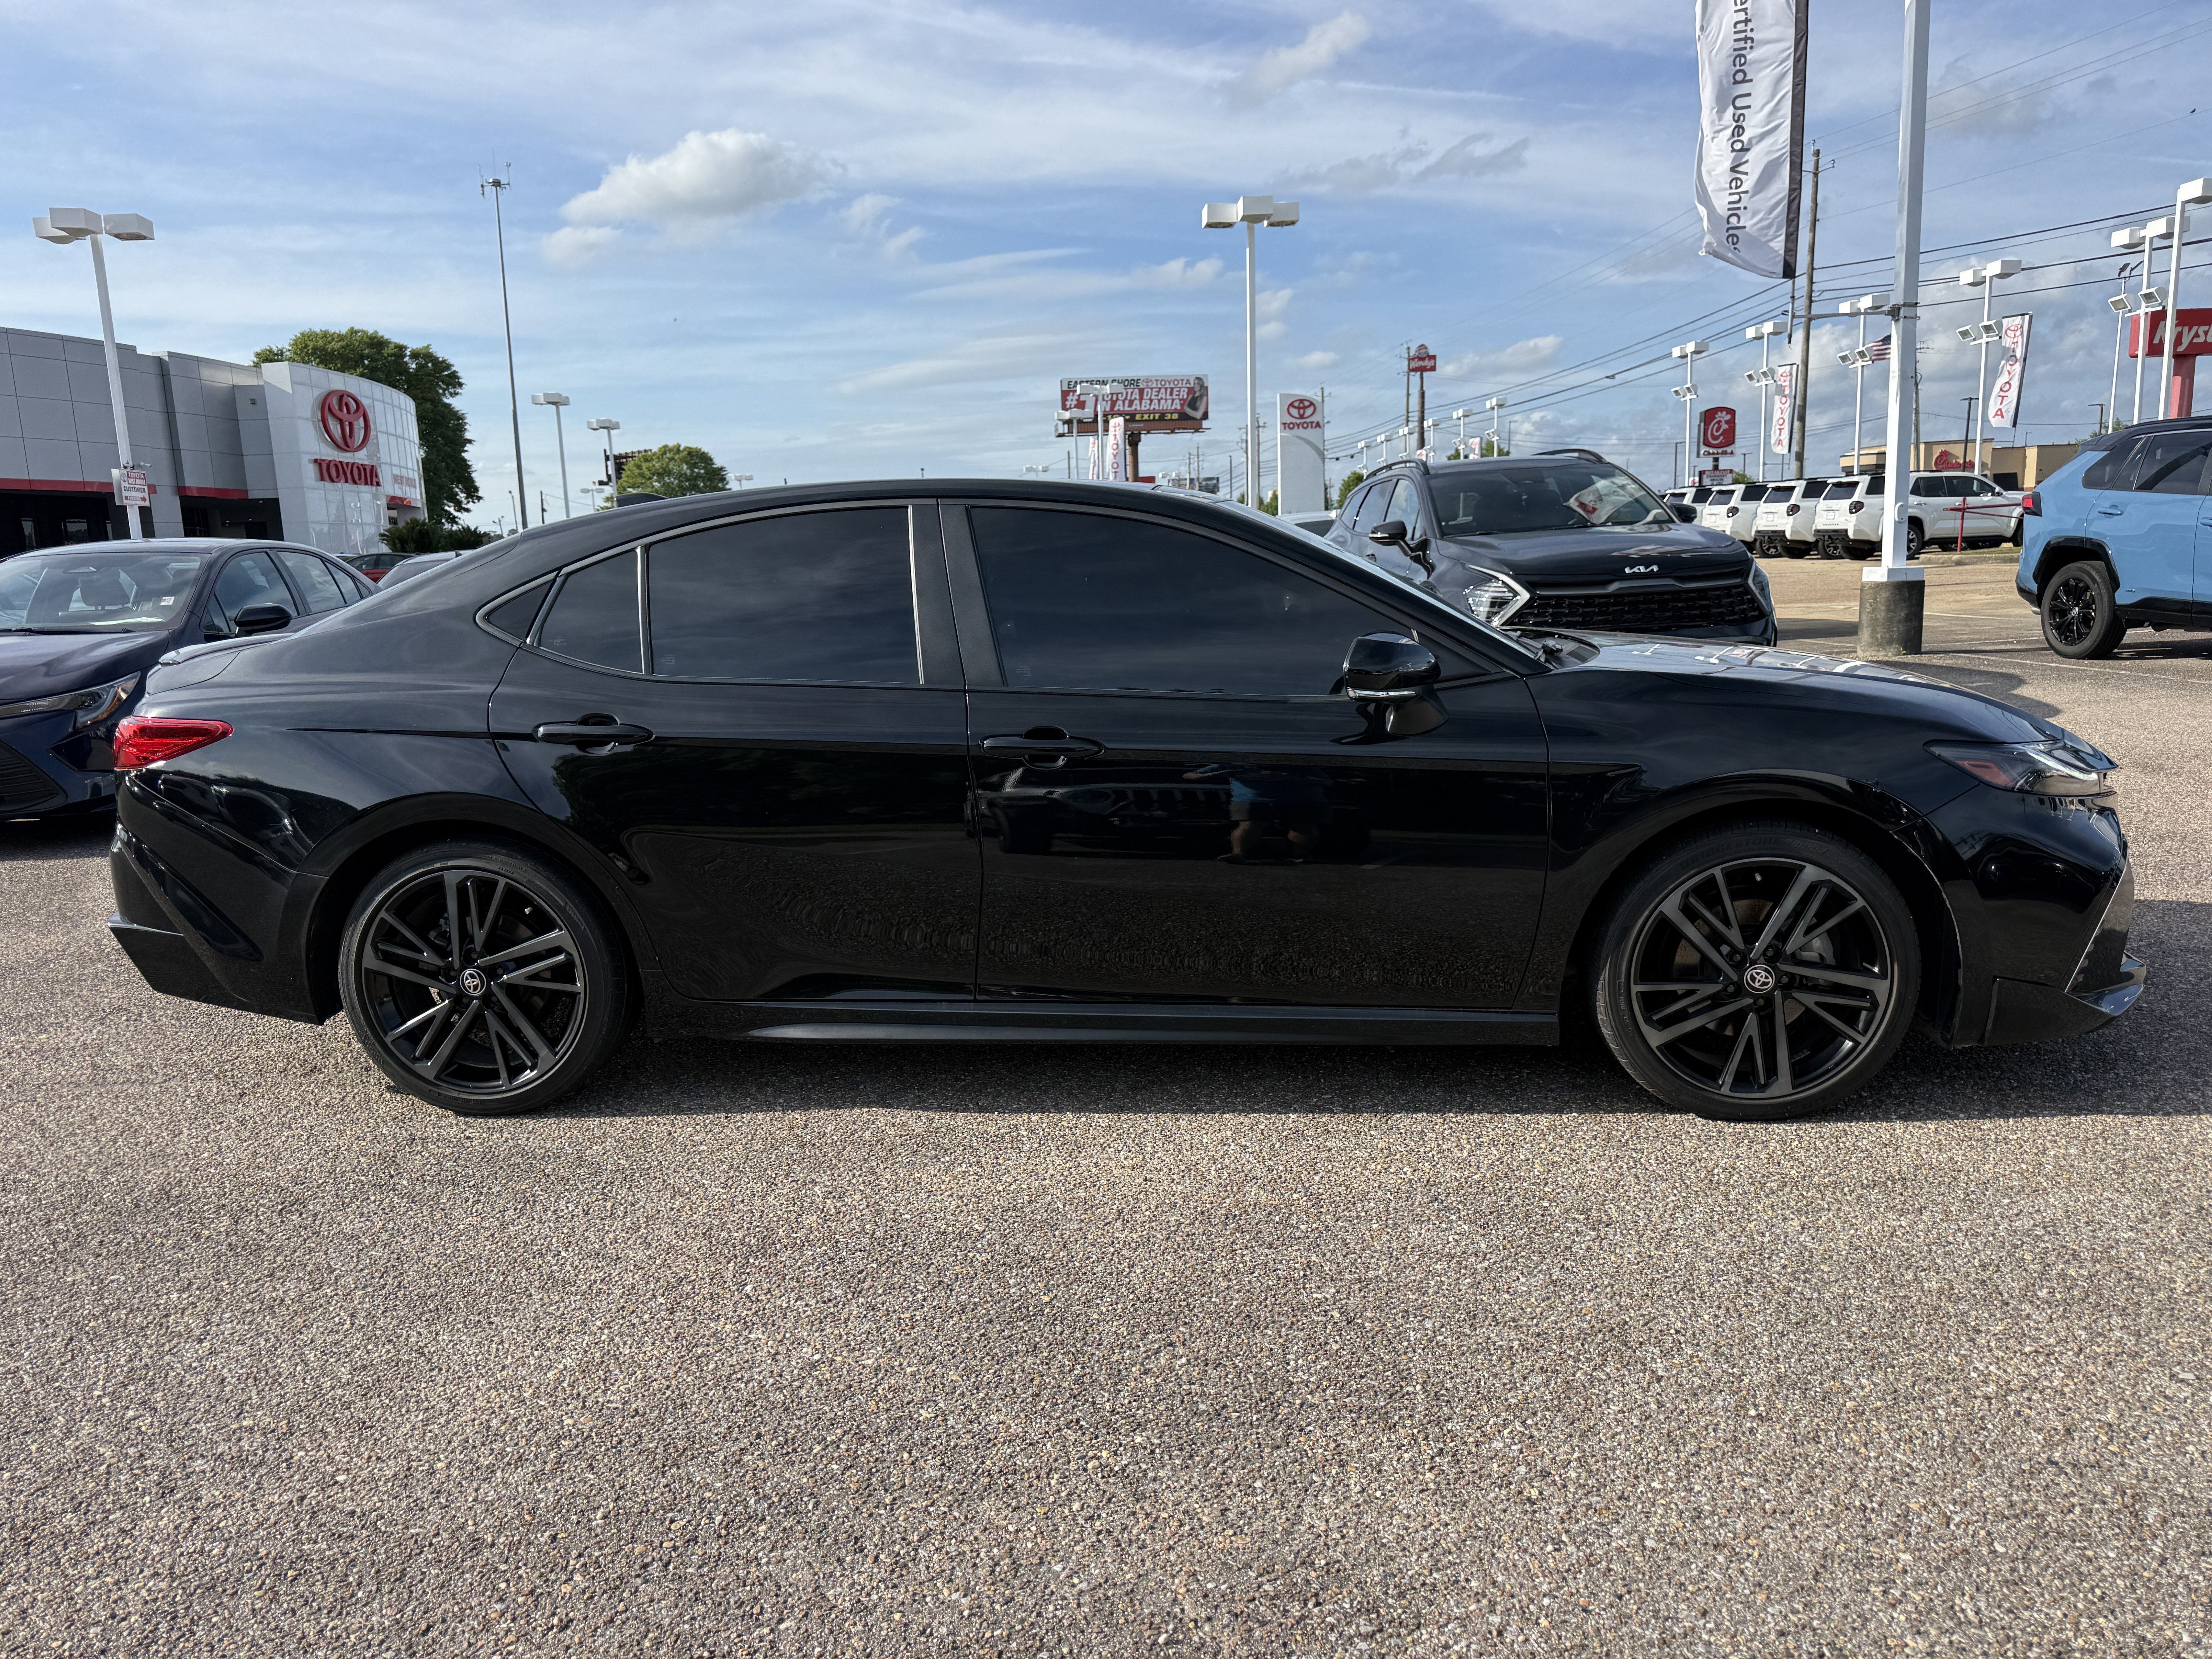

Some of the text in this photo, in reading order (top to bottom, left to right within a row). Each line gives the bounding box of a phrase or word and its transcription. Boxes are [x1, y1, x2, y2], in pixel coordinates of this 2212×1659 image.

[1731, 93, 1752, 153] Used
[1102, 388, 1188, 400] OYOTA DEALER
[1154, 378, 1191, 386] TOYOTA
[1992, 341, 2018, 419] TOYOTA
[1282, 421, 1322, 430] TOYOTA
[1777, 385, 1788, 447] TOYOTA
[314, 459, 381, 486] TOYOTA
[1111, 434, 1120, 479] TOYOT
